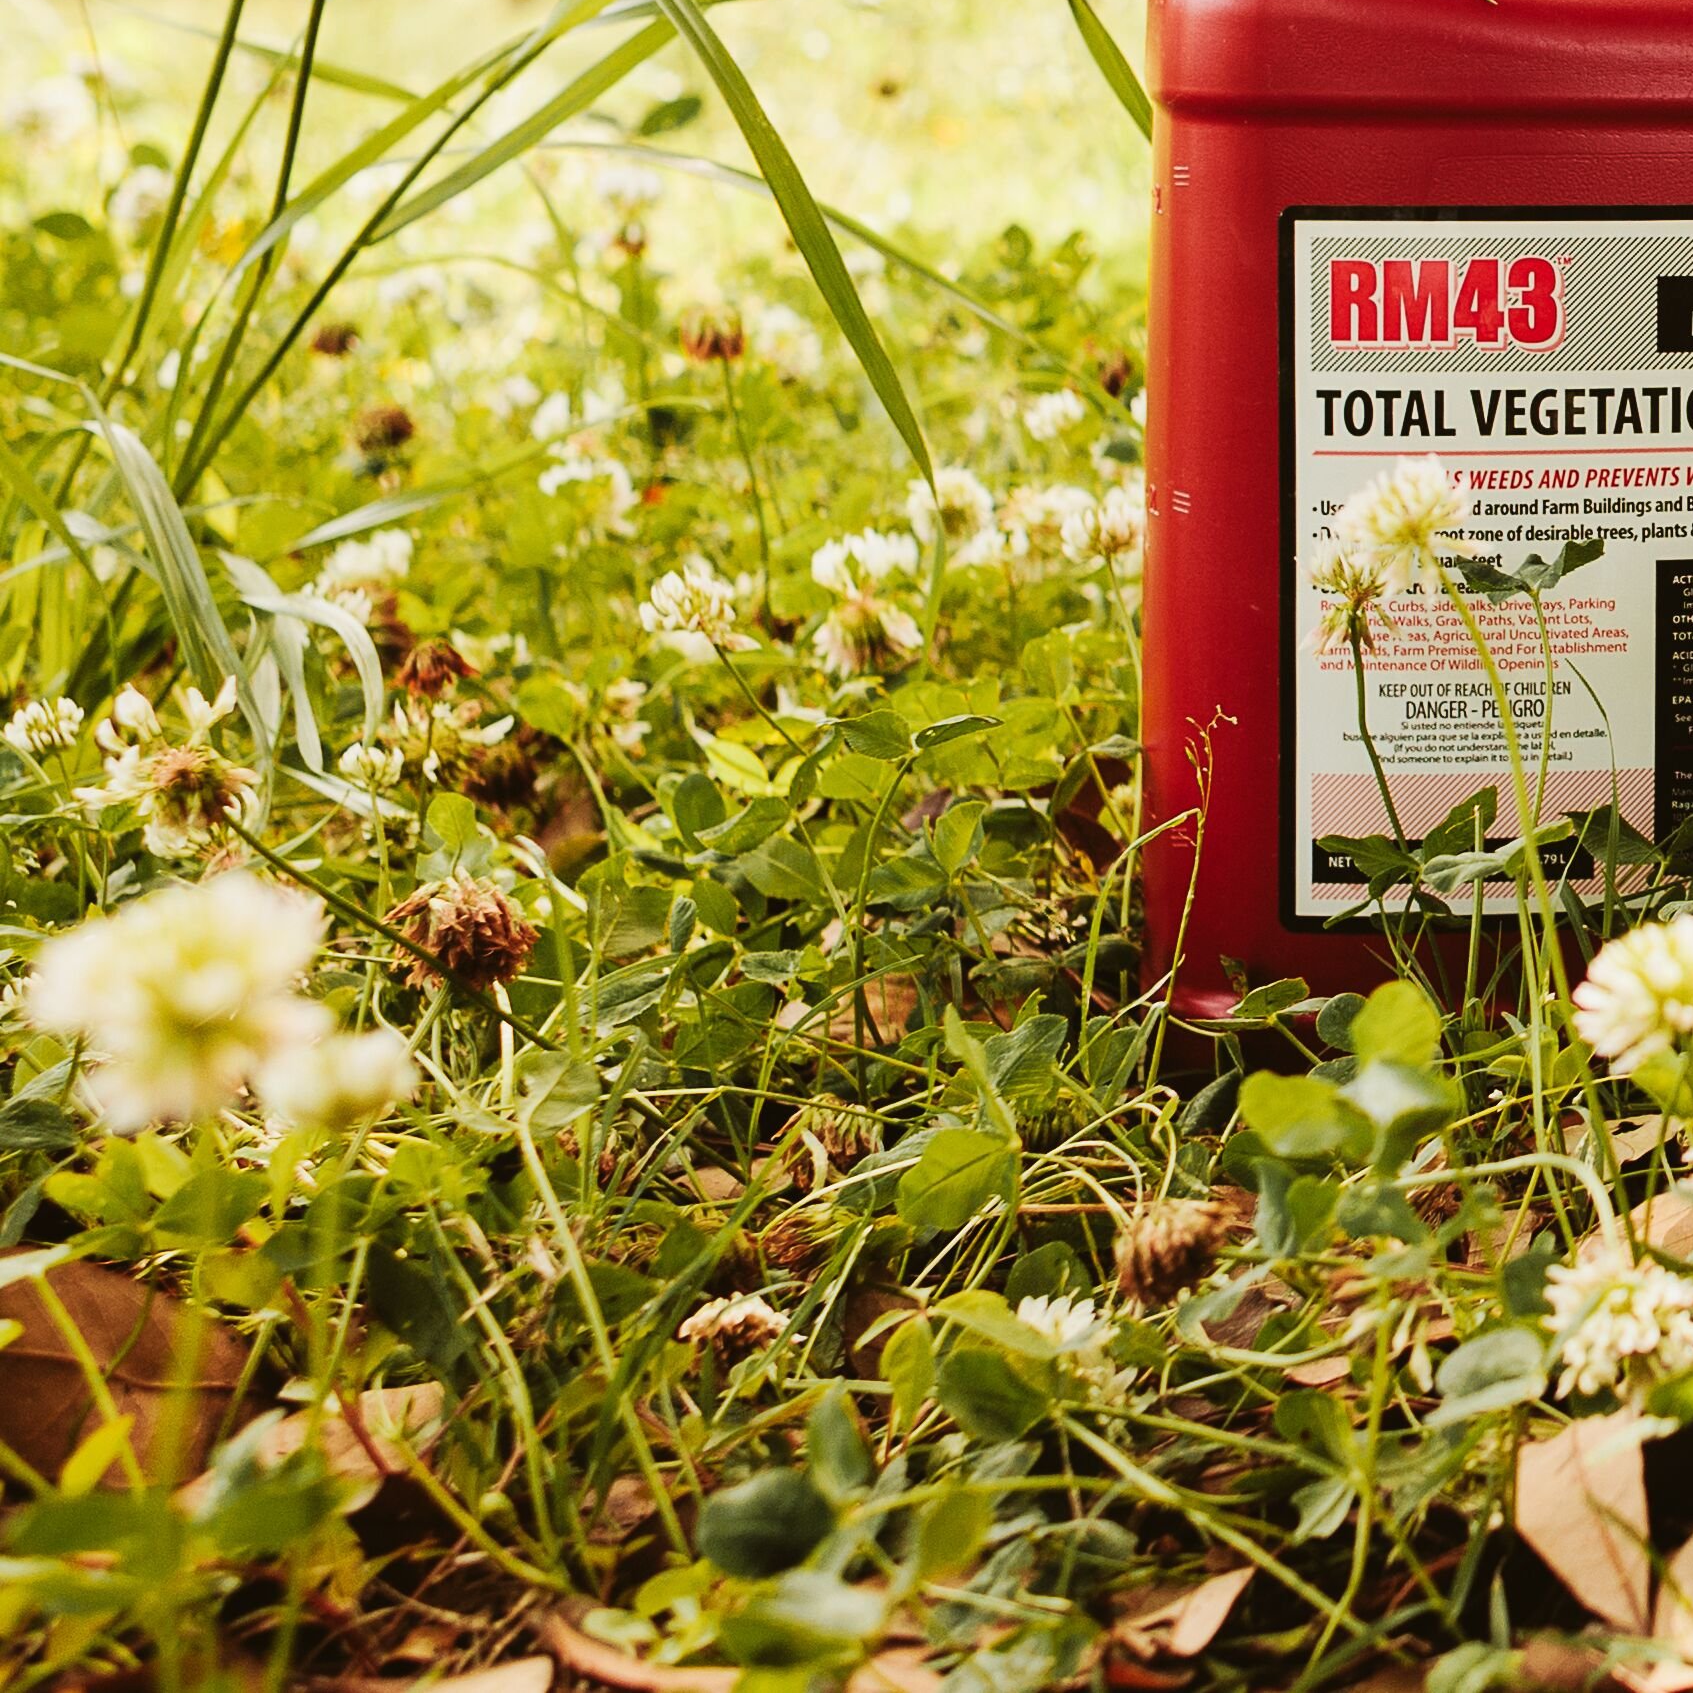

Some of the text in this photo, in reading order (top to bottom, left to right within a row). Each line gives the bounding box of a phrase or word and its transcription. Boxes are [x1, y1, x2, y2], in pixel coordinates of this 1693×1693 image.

[1329, 256, 1564, 352] RM43
[1316, 389, 1457, 437] TOTAL
[1469, 469, 1534, 490] WEEDS
[1538, 469, 1579, 489] AND
[1585, 467, 1680, 488] PREVENTS
[1485, 499, 1538, 516] around
[1542, 499, 1579, 515] Farm
[1583, 497, 1652, 517] Buildings
[1655, 496, 1683, 513] and
[1468, 529, 1503, 541] zone
[1507, 525, 1523, 541] of
[1527, 524, 1593, 541] desirable
[1597, 525, 1638, 542] trees,
[1641, 522, 1687, 543] plants
[1389, 601, 1428, 613] Curbs,
[1432, 600, 1496, 613] Sidealks,
[1500, 599, 1566, 612] Driveays,
[1569, 598, 1616, 611] Parking
[1393, 616, 1432, 628] Walks,
[1436, 615, 1475, 627] Gravl
[1479, 615, 1515, 626] Paths,
[1564, 613, 1593, 625] Lots,
[1433, 627, 1629, 644] Agricuural Uncutivated Areas,
[1320, 642, 1627, 656] arm Farm Premise and For Etablishment
[1320, 658, 1559, 672] and Mintenance Of Wildli Openins
[1379, 683, 1407, 697] KEEP
[1410, 683, 1433, 697] OUT
[1437, 683, 1452, 696] OF
[1455, 683, 1493, 696] REACH
[1672, 696, 1691, 705] EPA
[1406, 699, 1545, 719] DANGER PEIGRO
[1675, 713, 1691, 722] See
[1674, 770, 1692, 779] The
[1328, 856, 1351, 868] NET
[1560, 853, 1566, 864] L
